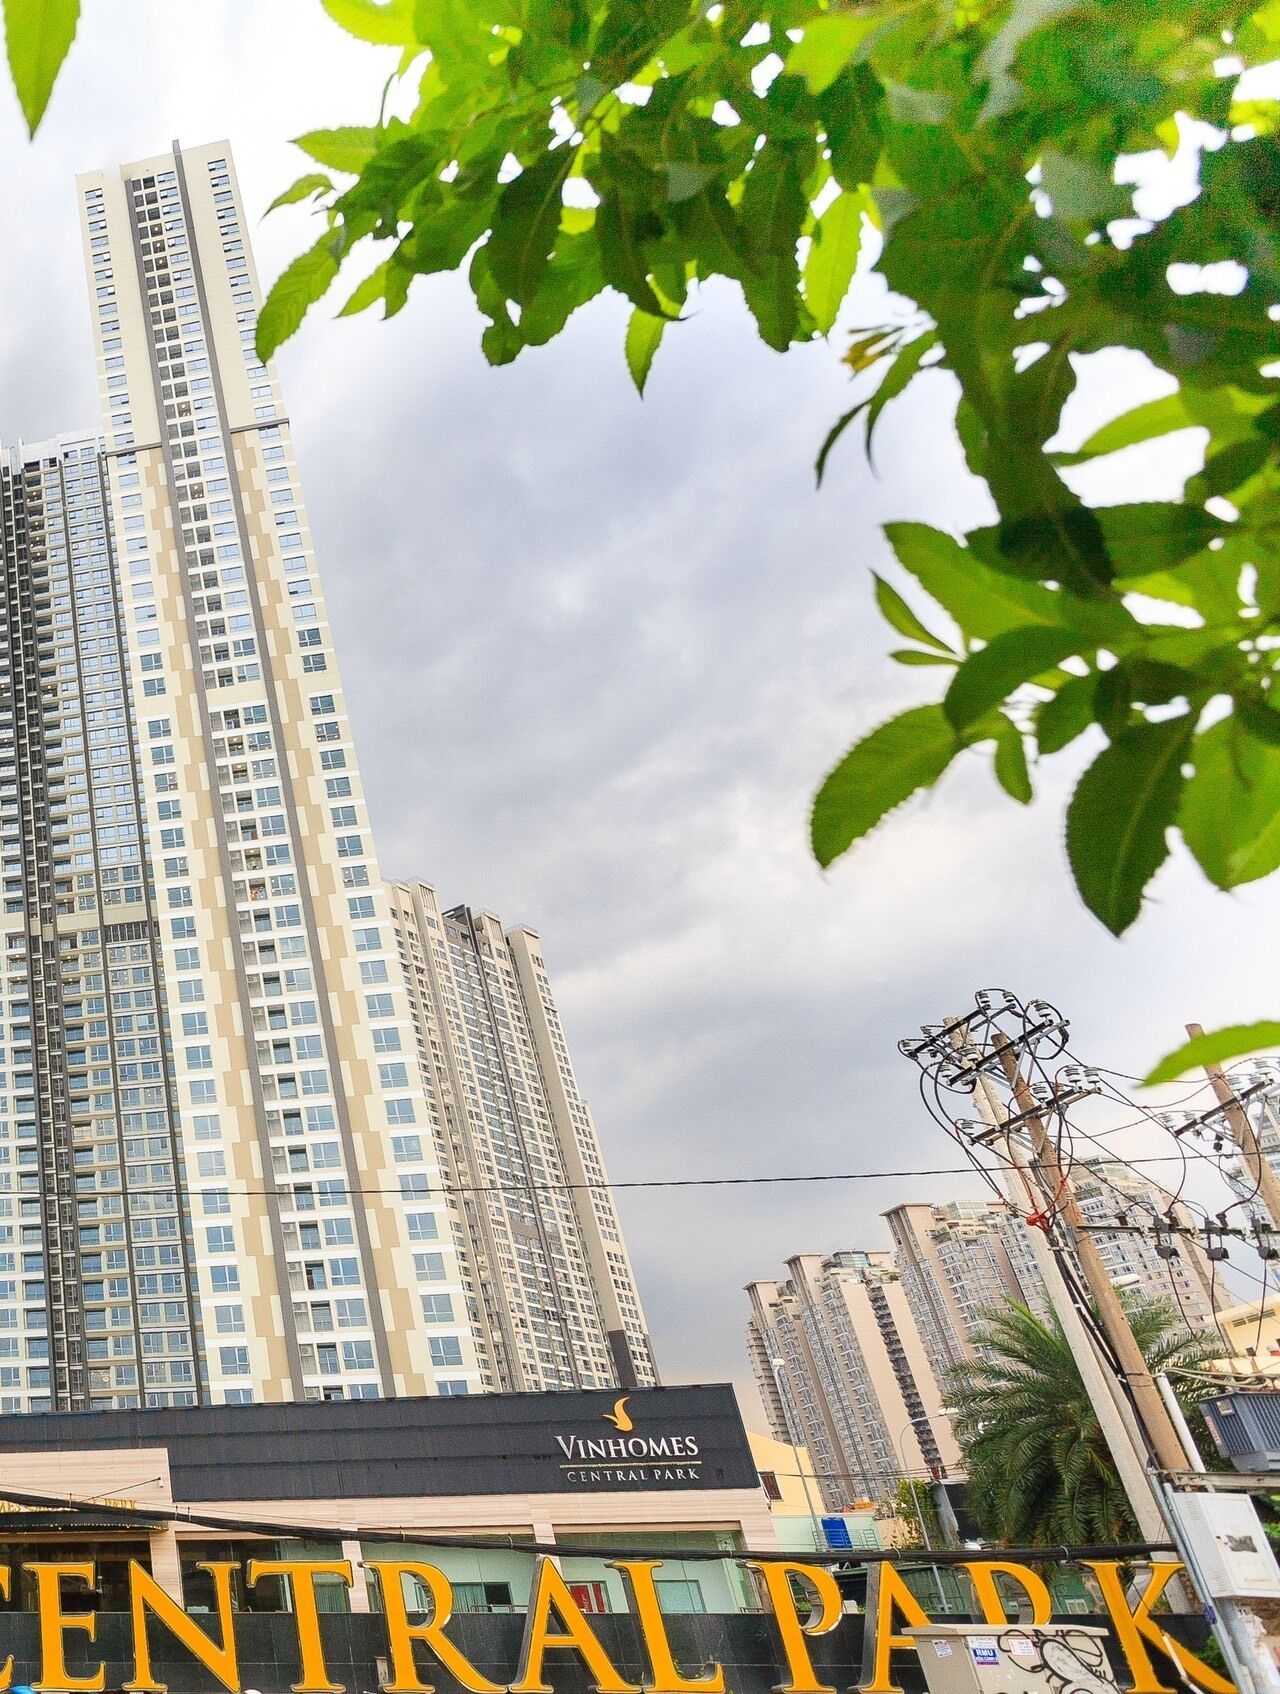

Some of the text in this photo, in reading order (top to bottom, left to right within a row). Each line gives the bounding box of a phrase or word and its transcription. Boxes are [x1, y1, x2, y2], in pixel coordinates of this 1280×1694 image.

[553, 1434, 699, 1460] VINHOMES
[567, 1467, 700, 1483] CENTRAL PARK
